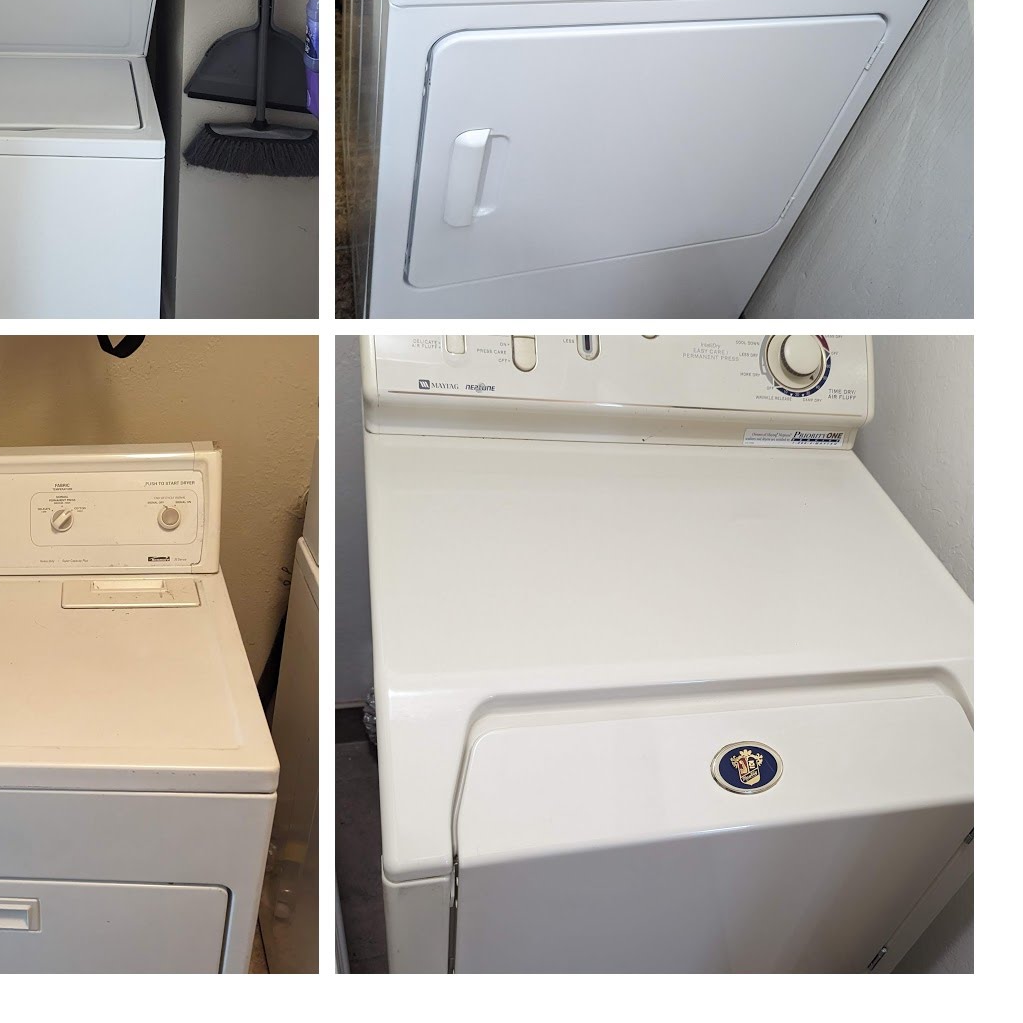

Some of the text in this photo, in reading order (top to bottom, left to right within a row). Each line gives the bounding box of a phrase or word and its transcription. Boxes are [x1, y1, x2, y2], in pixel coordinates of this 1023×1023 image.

[412, 338, 438, 346] DELICATE
[682, 352, 740, 363] PERMANENT PRESS
[431, 382, 459, 390] MAYTAG
[793, 431, 826, 439] PRIORITY
